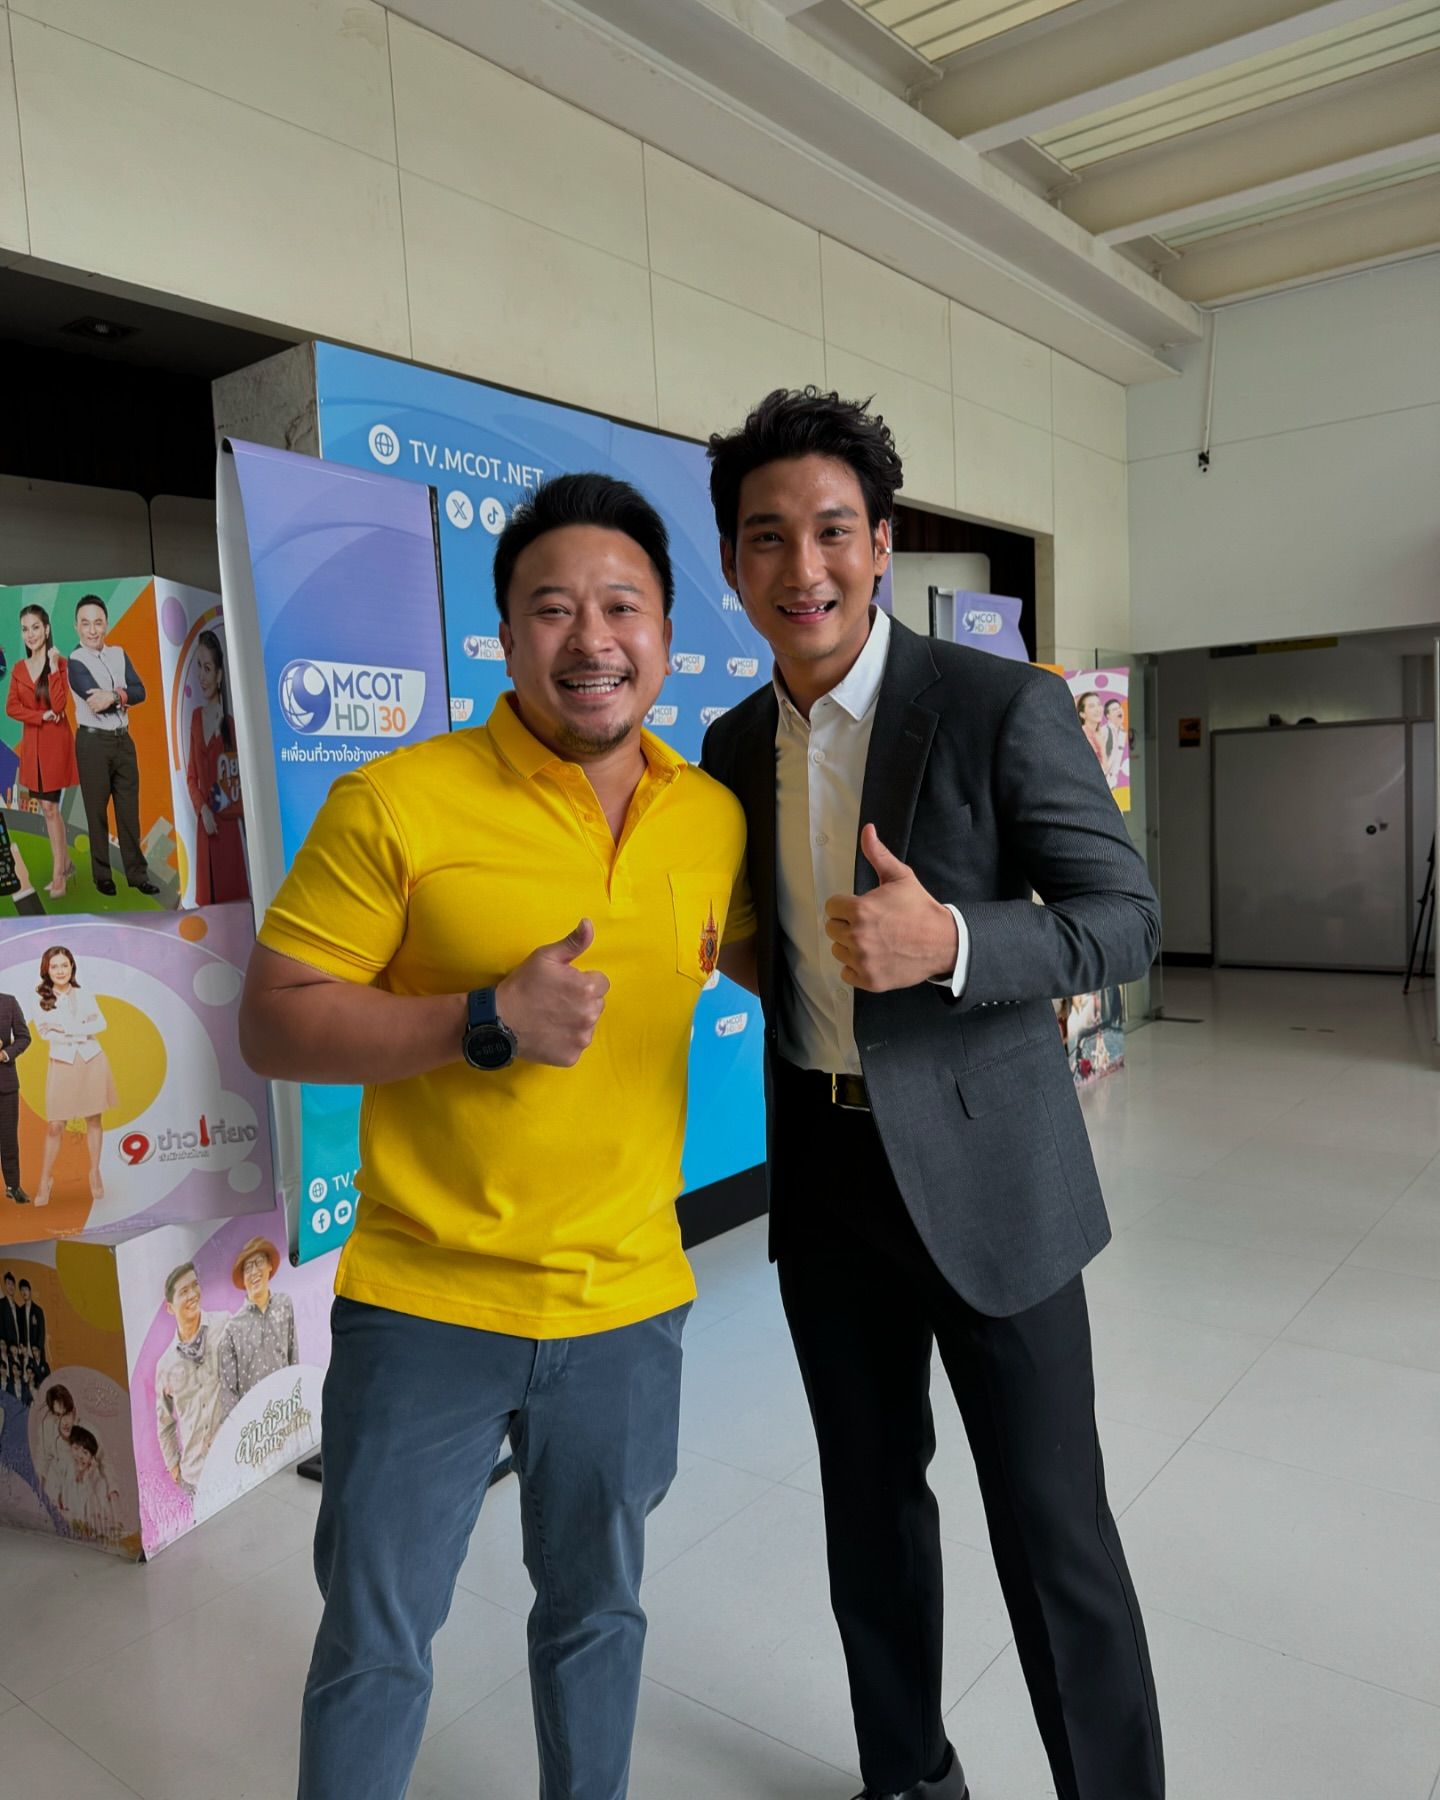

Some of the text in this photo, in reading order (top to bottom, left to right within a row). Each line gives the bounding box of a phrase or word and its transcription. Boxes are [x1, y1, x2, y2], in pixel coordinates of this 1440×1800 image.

[409, 439, 544, 490] TV.MCOT.NET
[975, 613, 997, 624] MCOT
[480, 639, 502, 650] MCO
[332, 669, 403, 702] MCOT
